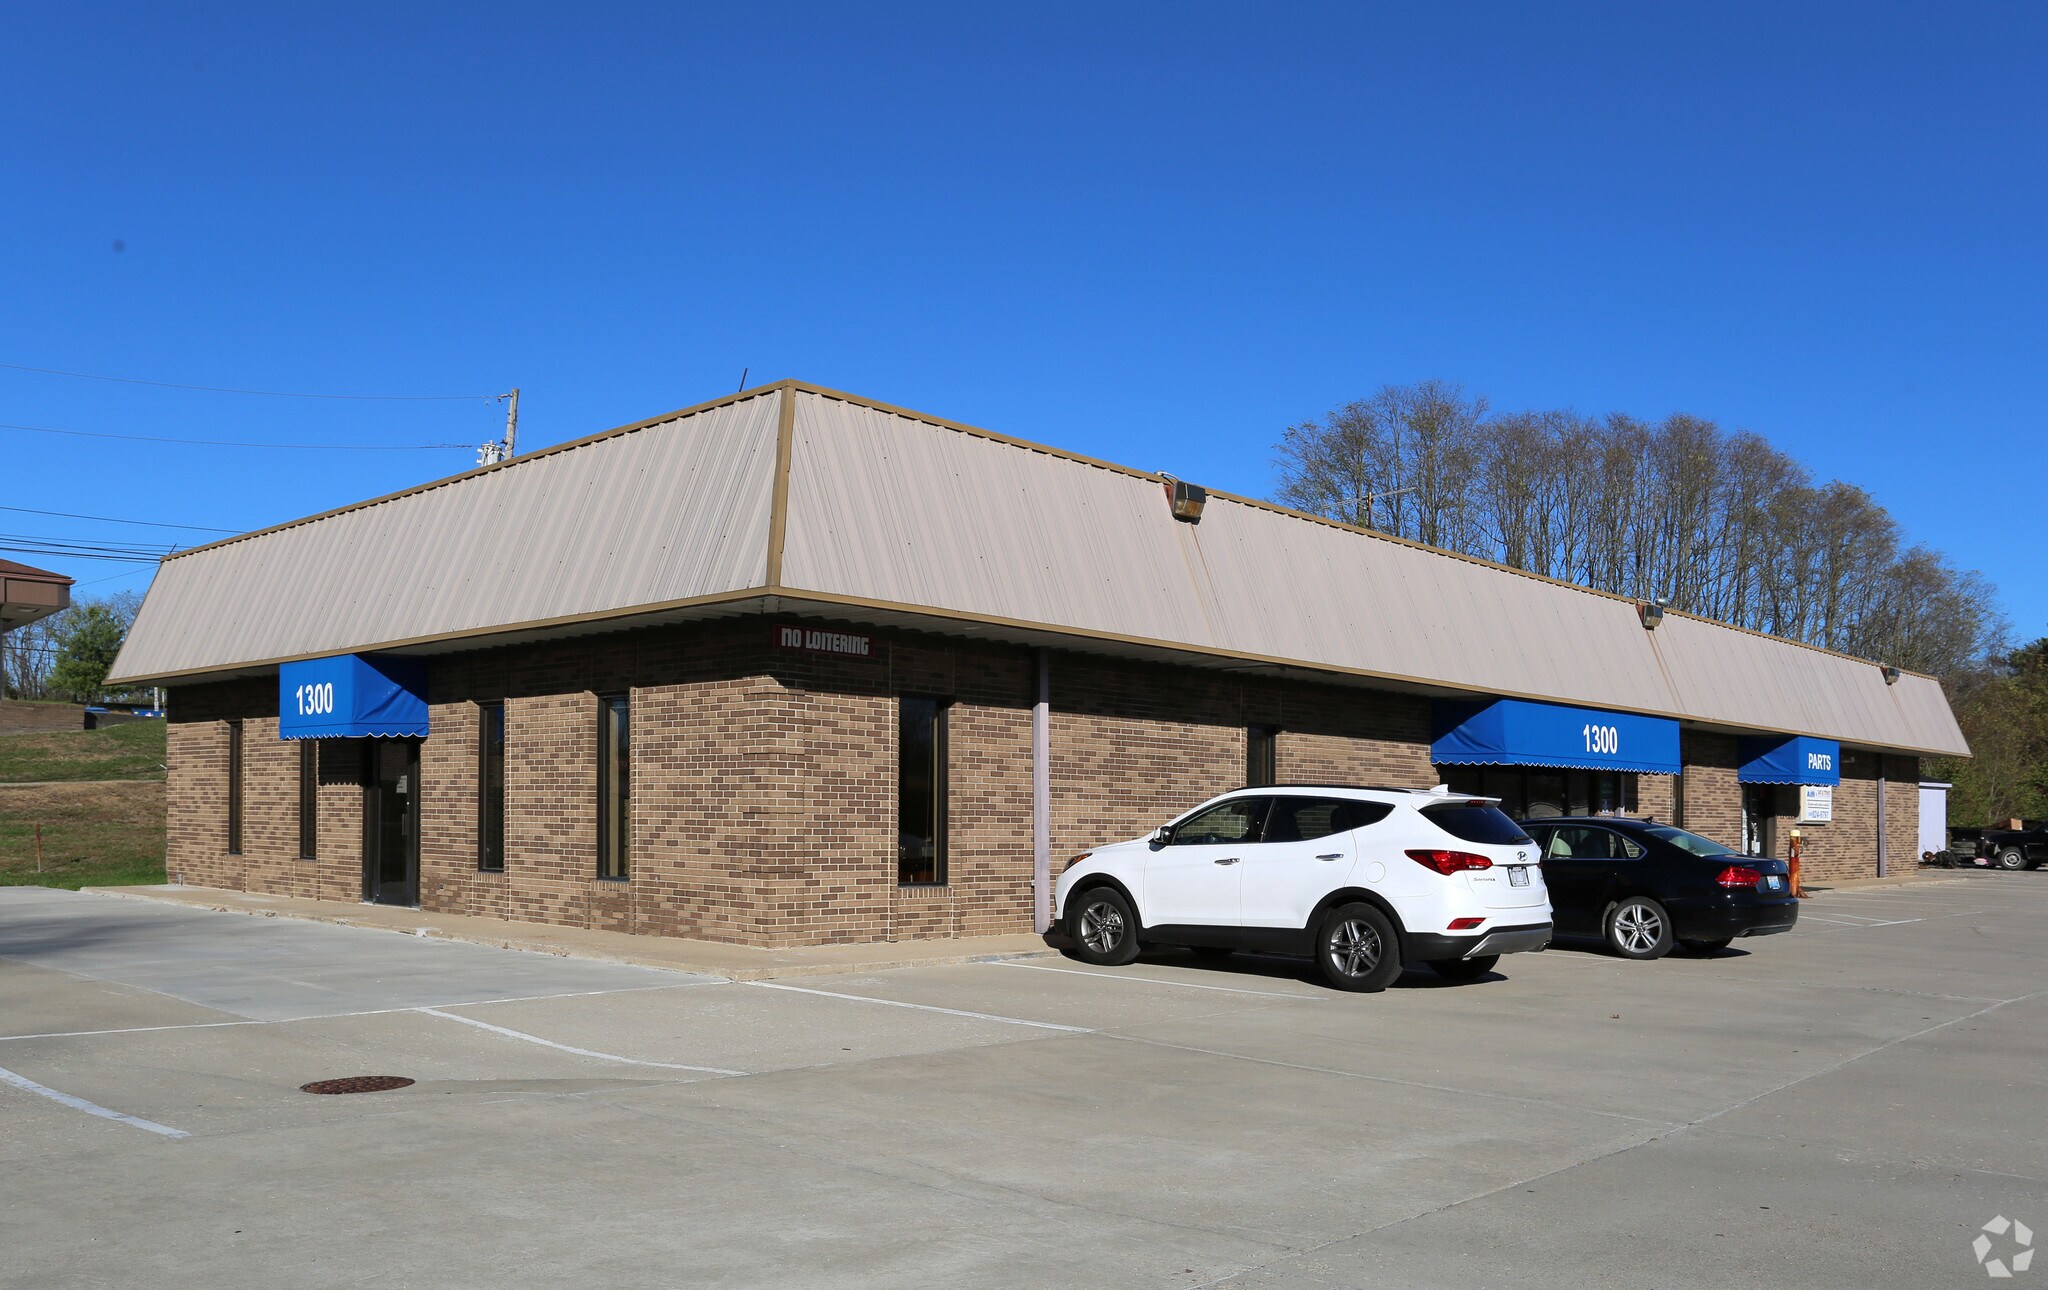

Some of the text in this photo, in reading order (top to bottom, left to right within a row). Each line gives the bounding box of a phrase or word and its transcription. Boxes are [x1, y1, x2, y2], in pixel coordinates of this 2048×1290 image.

[781, 627, 869, 655] NO LOITERING
[296, 682, 333, 715] 1300
[1582, 724, 1618, 754] 1300
[1808, 752, 1831, 770] PARTS
